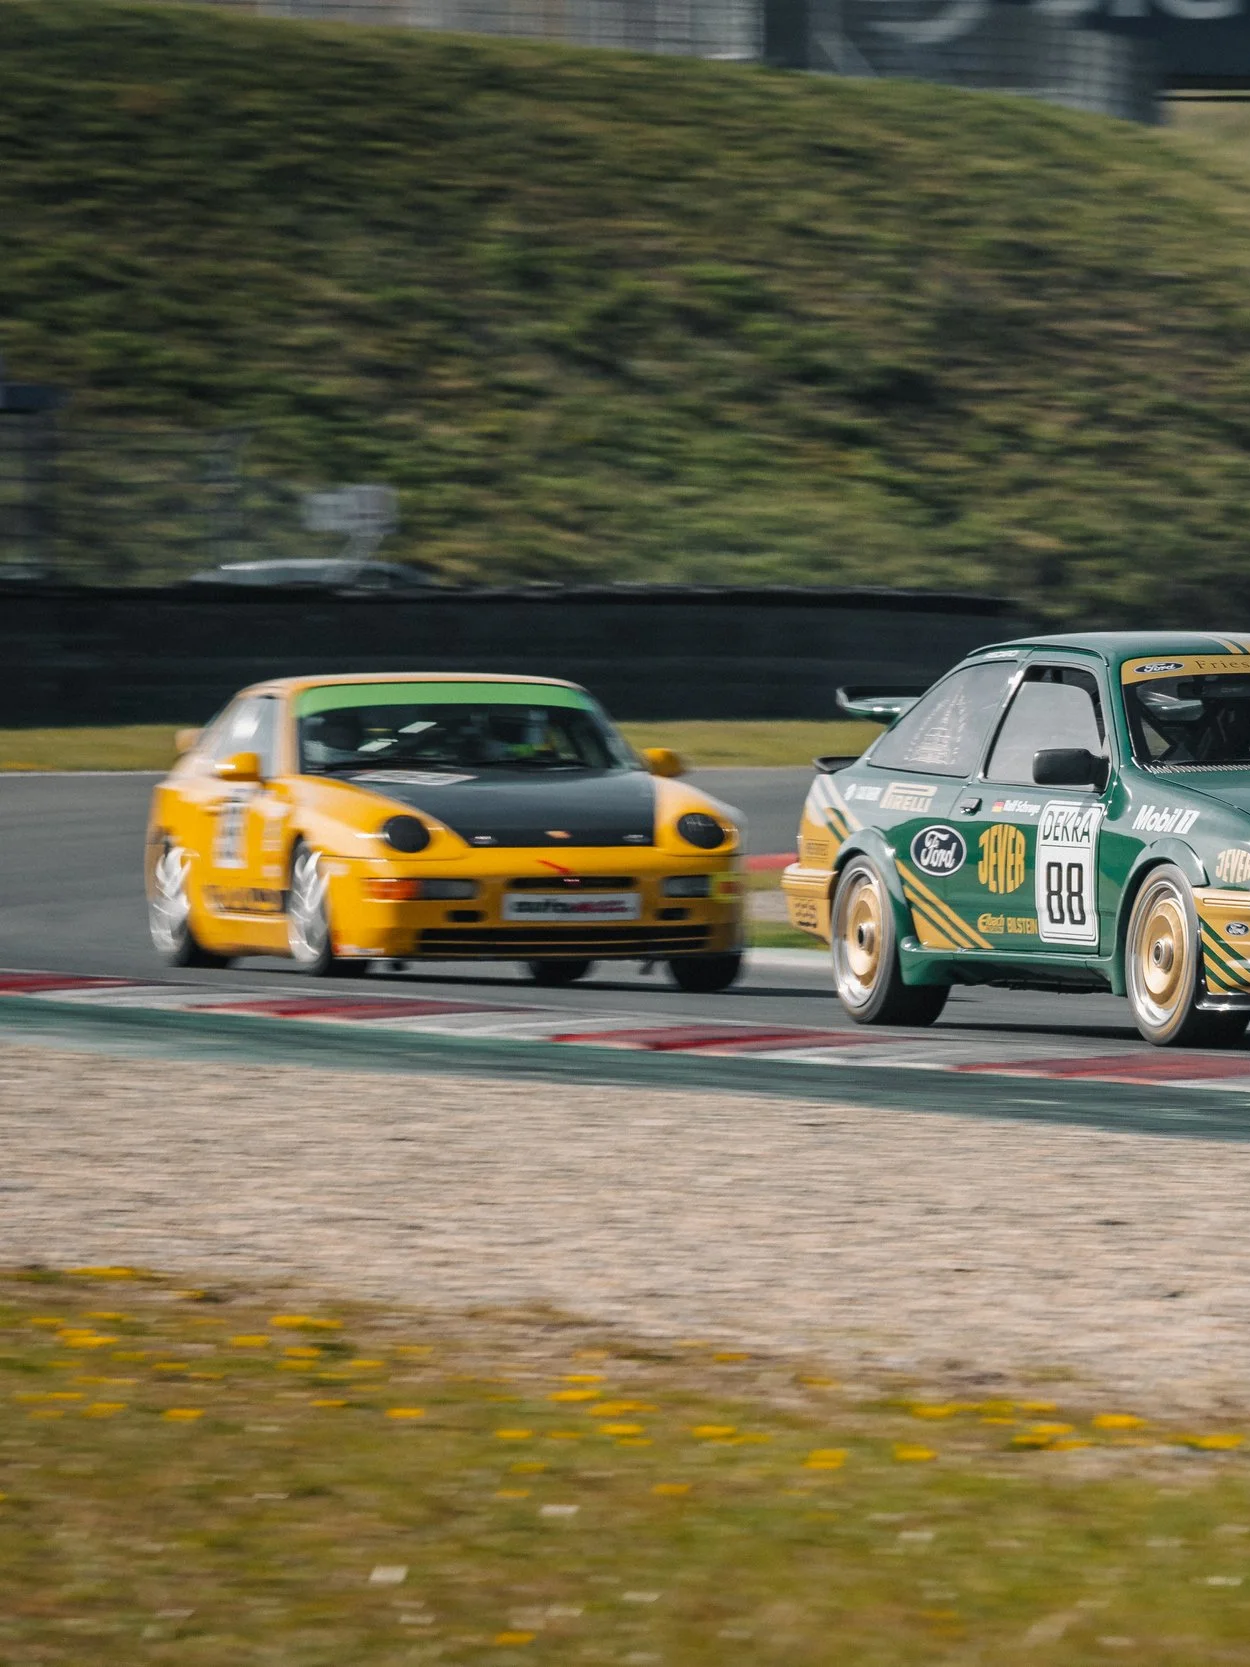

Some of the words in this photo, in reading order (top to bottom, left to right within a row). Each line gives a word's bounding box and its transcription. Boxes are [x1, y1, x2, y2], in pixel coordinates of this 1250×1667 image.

[1043, 810, 1092, 843] DEKRA
[1132, 804, 1183, 832] Mobil
[920, 830, 956, 869] Ford
[978, 824, 1026, 894] JEVER
[1046, 861, 1086, 925] 88
